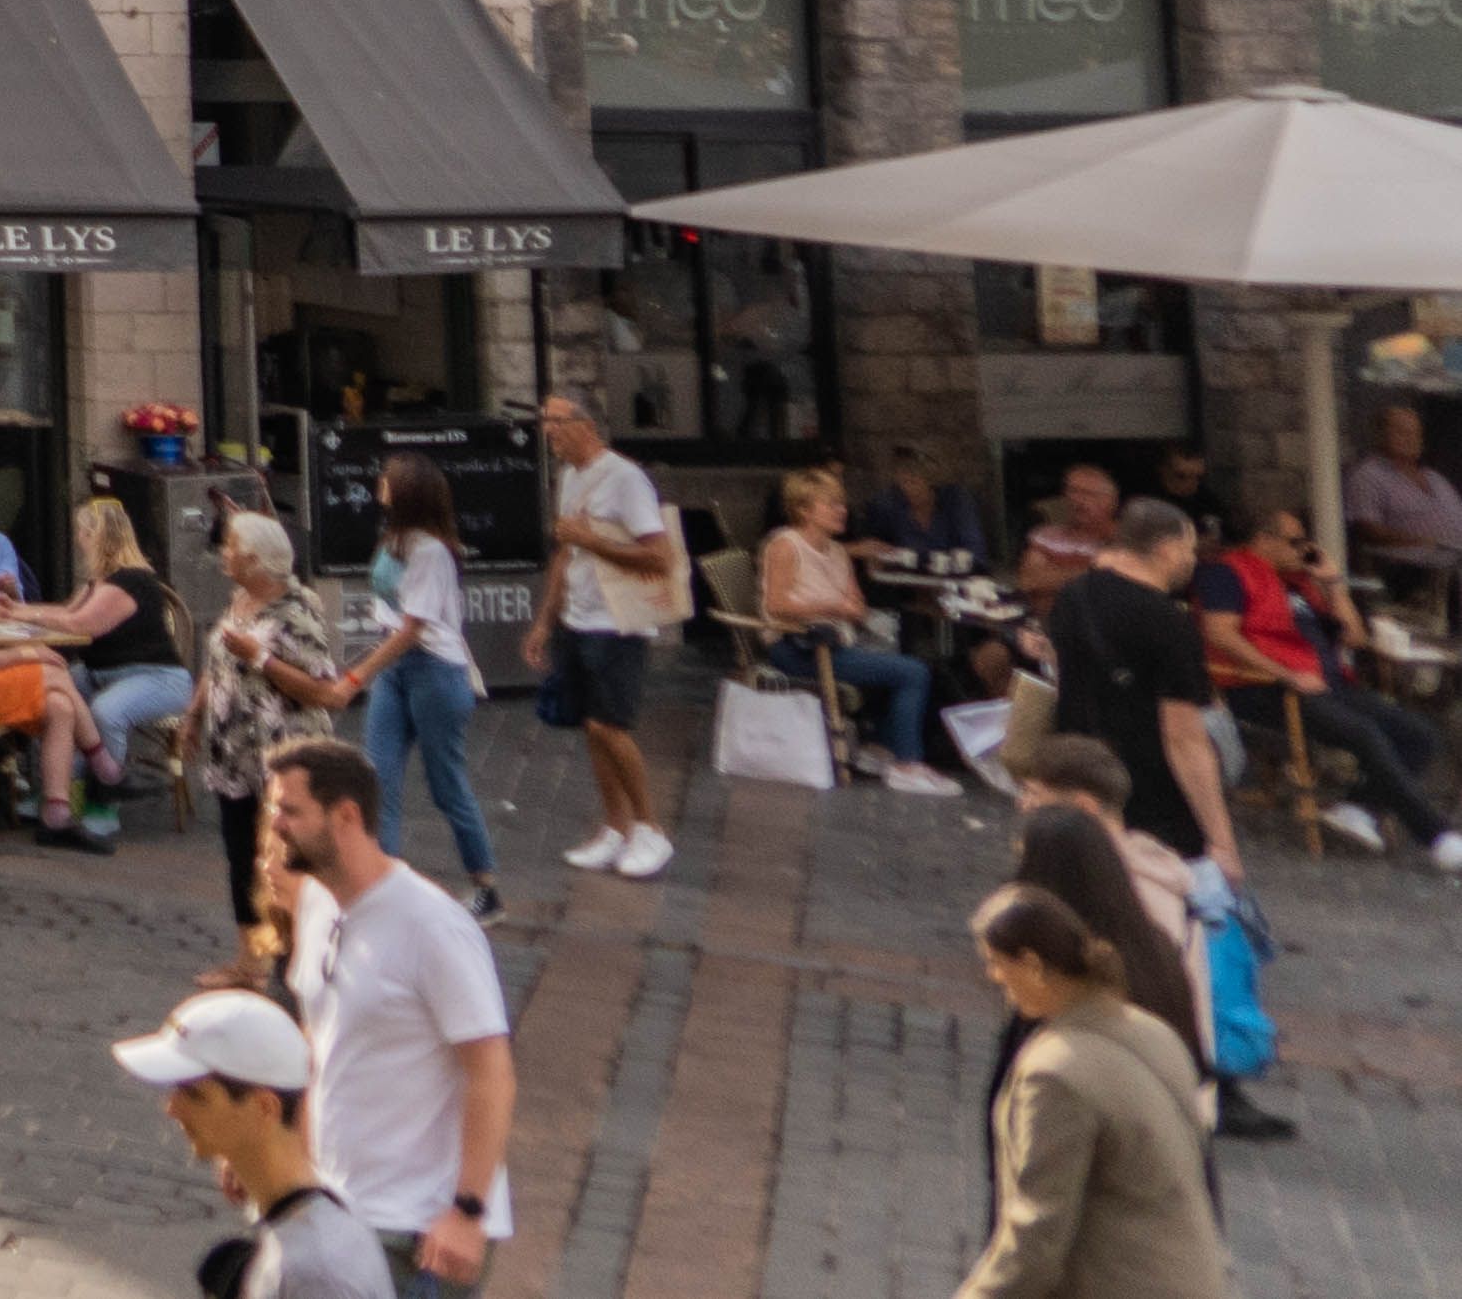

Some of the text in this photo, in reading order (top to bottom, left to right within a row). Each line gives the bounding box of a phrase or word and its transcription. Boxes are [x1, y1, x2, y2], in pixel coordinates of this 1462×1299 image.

[41, 224, 118, 253] LYS
[425, 224, 553, 254] LE LYS
